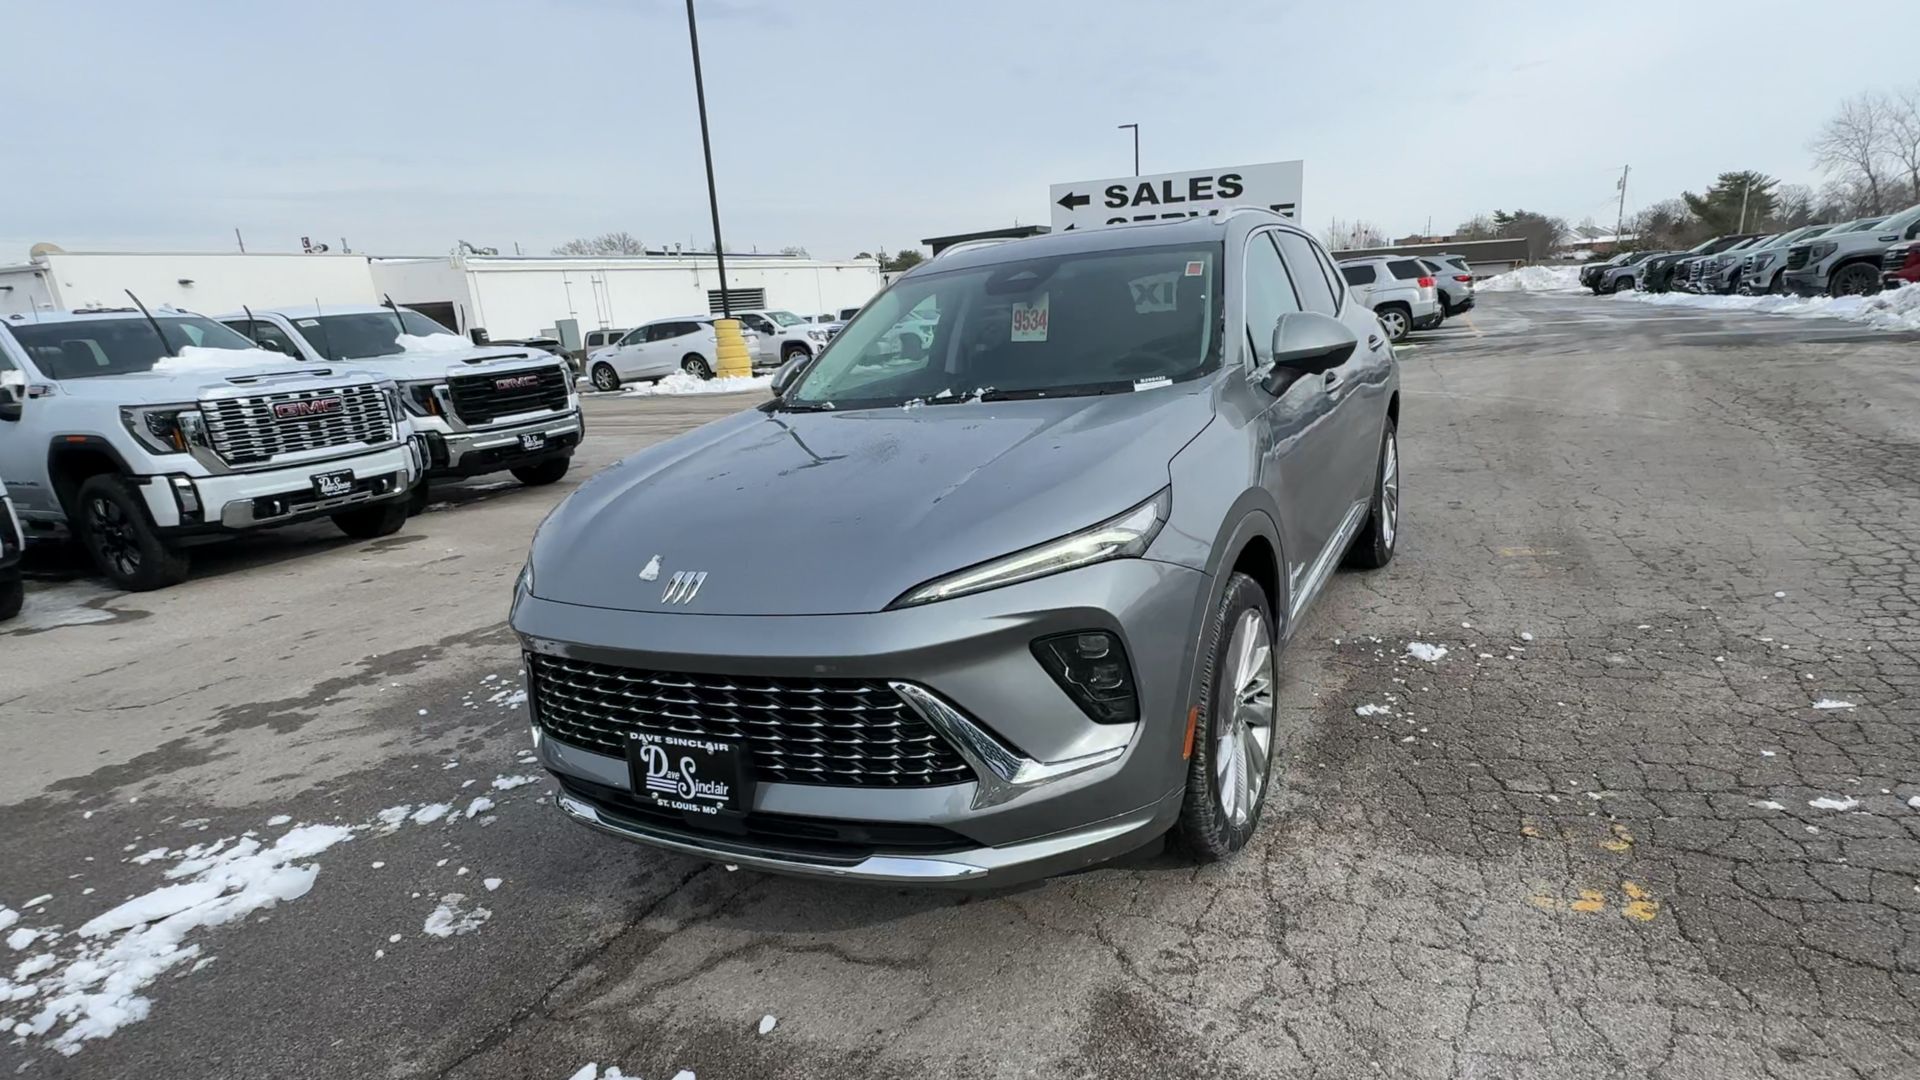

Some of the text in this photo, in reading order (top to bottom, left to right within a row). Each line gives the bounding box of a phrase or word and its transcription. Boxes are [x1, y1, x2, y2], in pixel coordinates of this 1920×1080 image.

[1104, 173, 1243, 209] SALES
[1014, 310, 1047, 331] 9534
[496, 375, 538, 389] GMC
[275, 399, 342, 418] GMC
[630, 732, 729, 751] DAVE SINCLAIR
[640, 745, 729, 799] Dave Sinclair
[702, 805, 717, 814] MO
